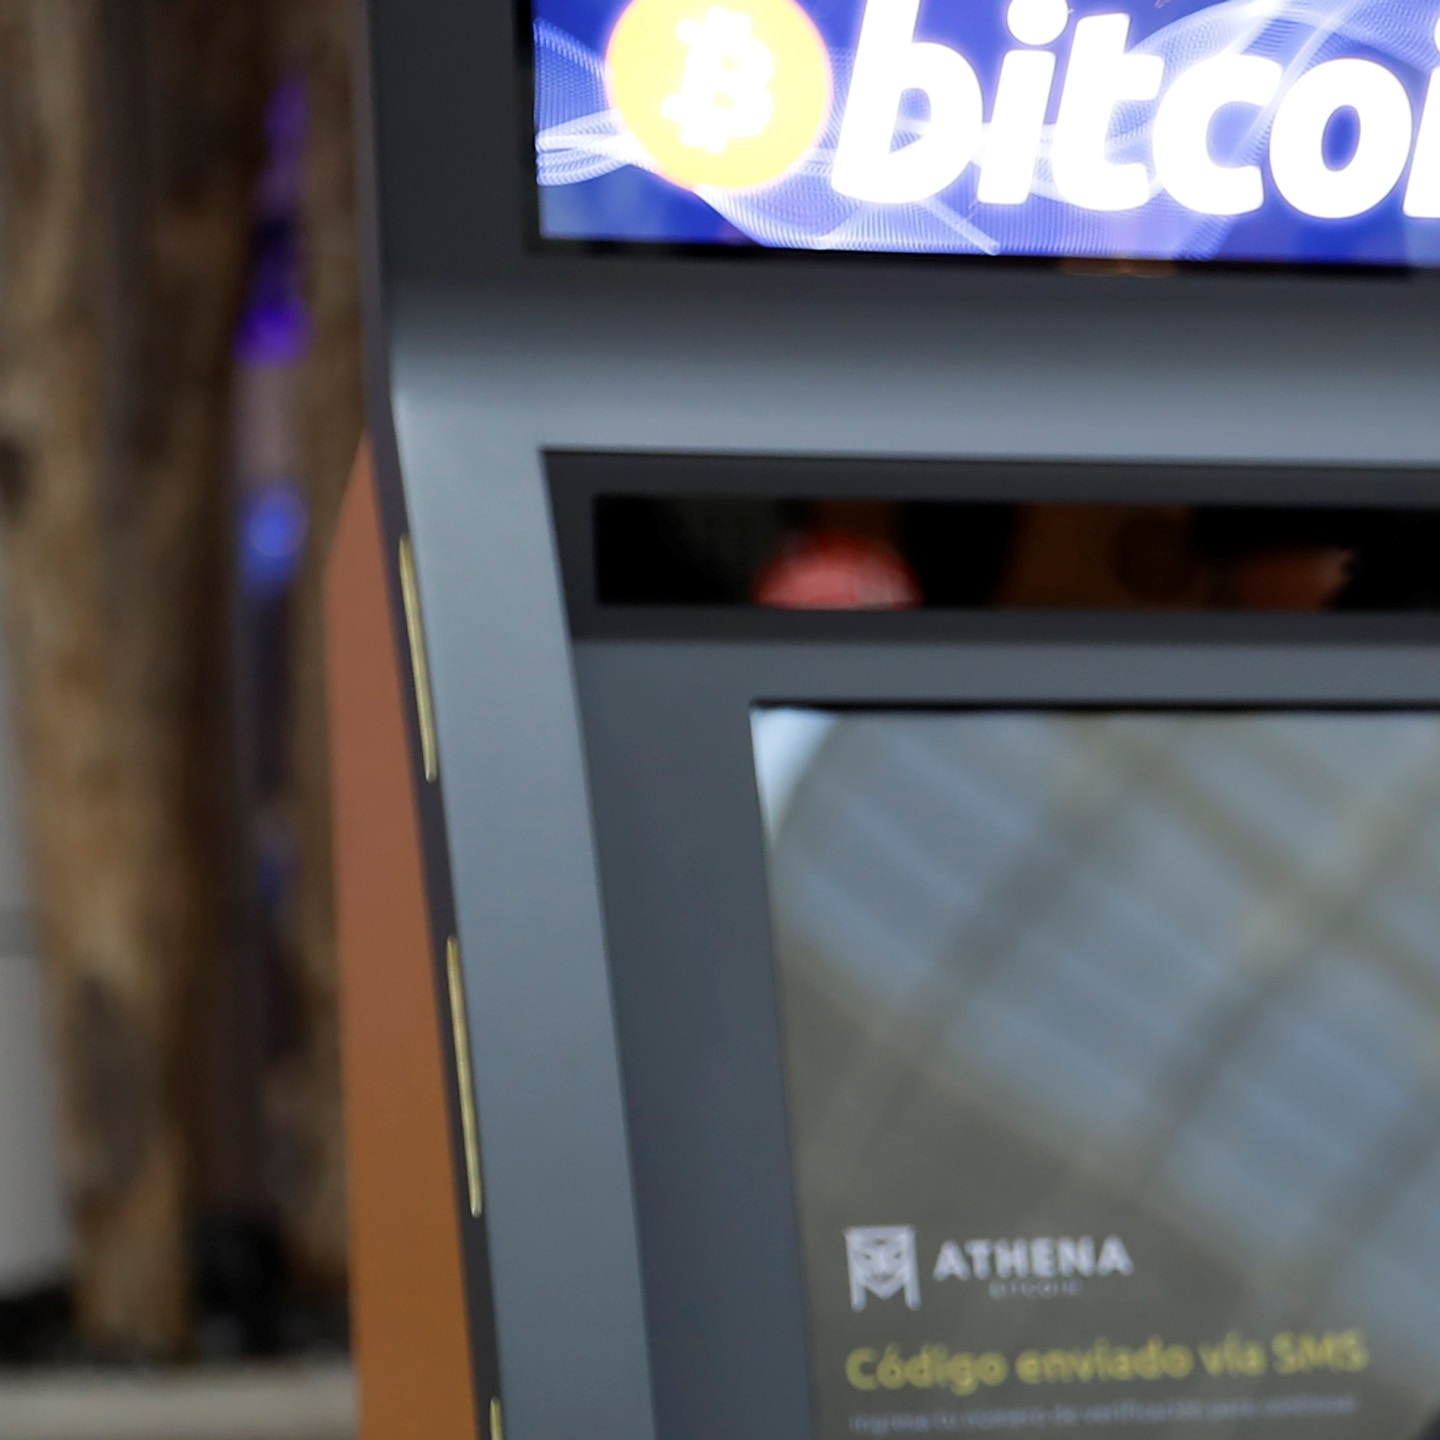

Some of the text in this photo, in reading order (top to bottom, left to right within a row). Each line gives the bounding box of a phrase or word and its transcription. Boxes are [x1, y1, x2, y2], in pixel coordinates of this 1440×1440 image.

[933, 1236, 1134, 1281] ATHENA
[846, 1329, 1369, 1394] Código enviado vía SMS
